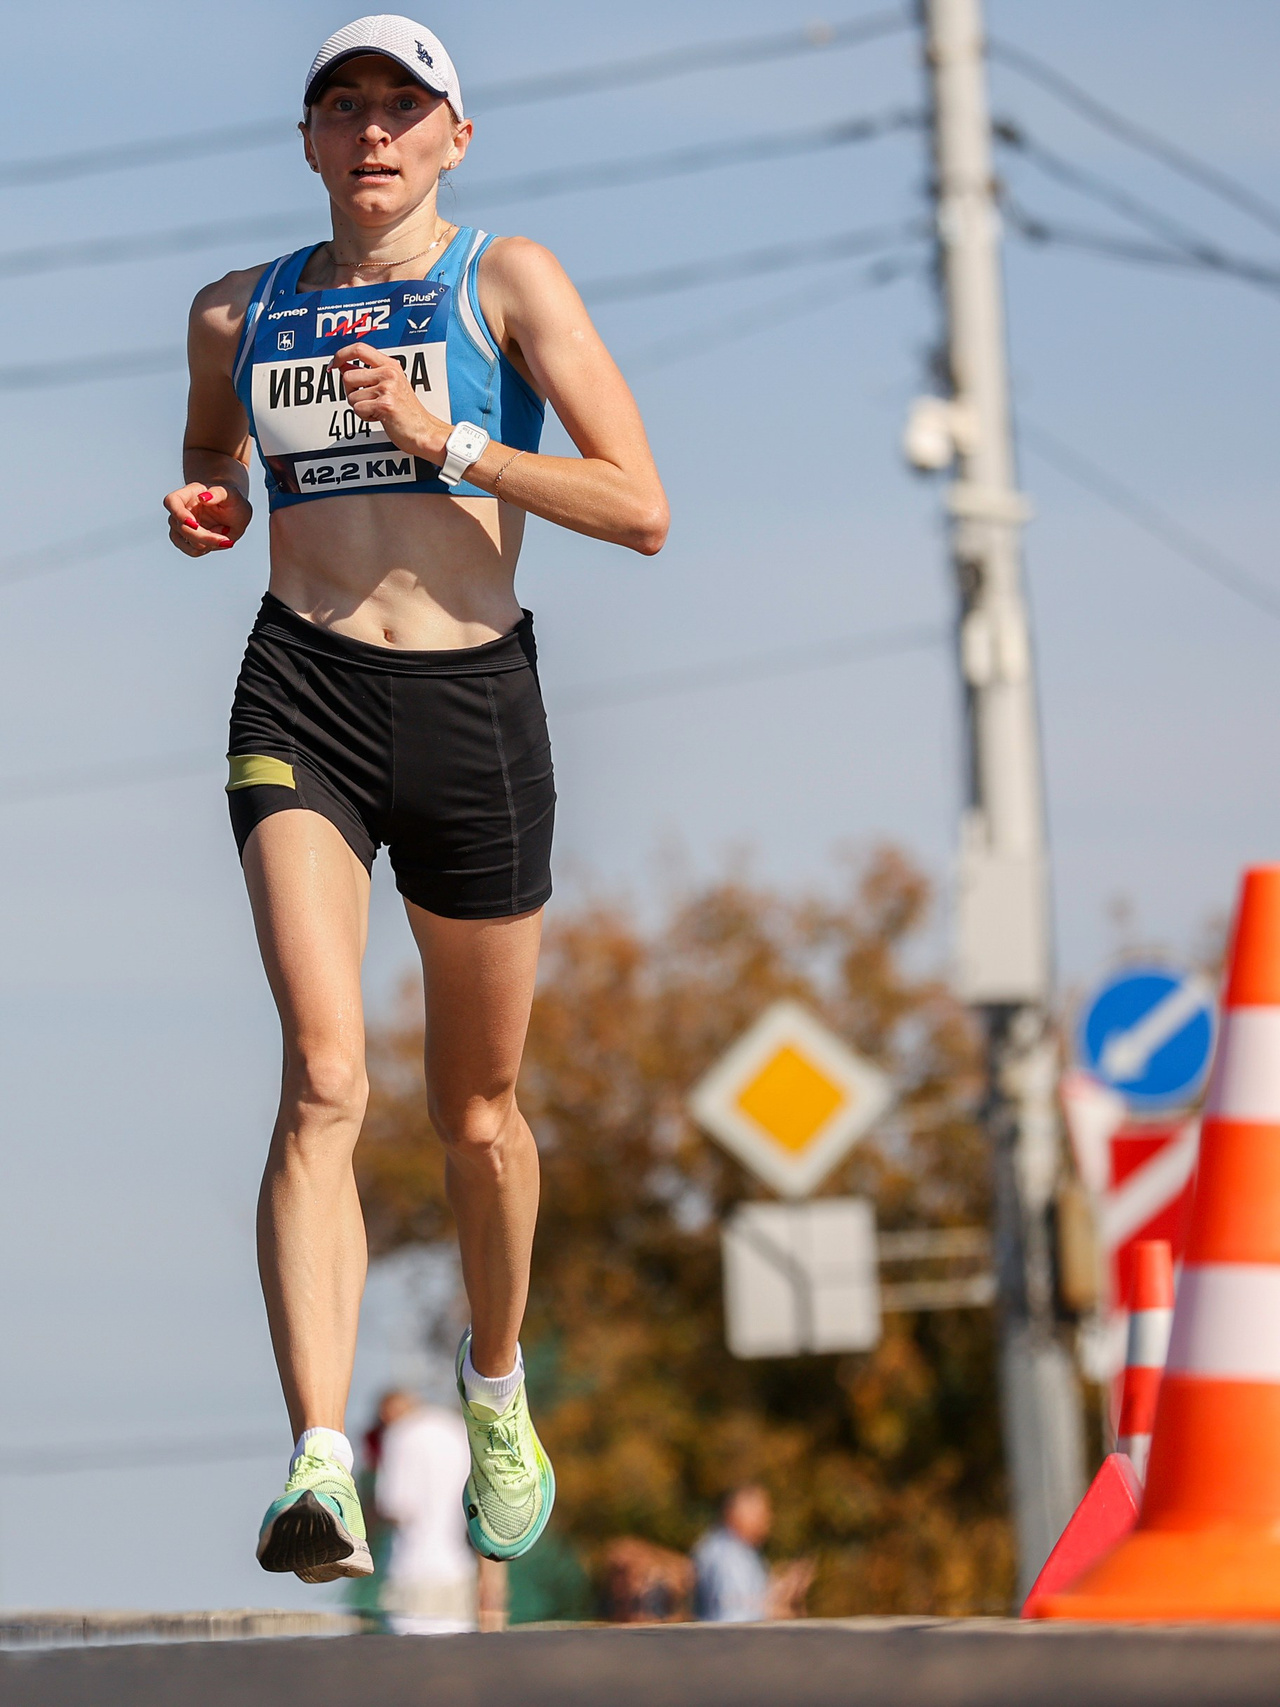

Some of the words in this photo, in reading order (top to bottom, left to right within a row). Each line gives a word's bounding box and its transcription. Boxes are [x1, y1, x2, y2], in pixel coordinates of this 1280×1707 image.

[267, 308, 309, 320] купер
[269, 351, 432, 409] ИВАА
[301, 463, 361, 485] 42,2
